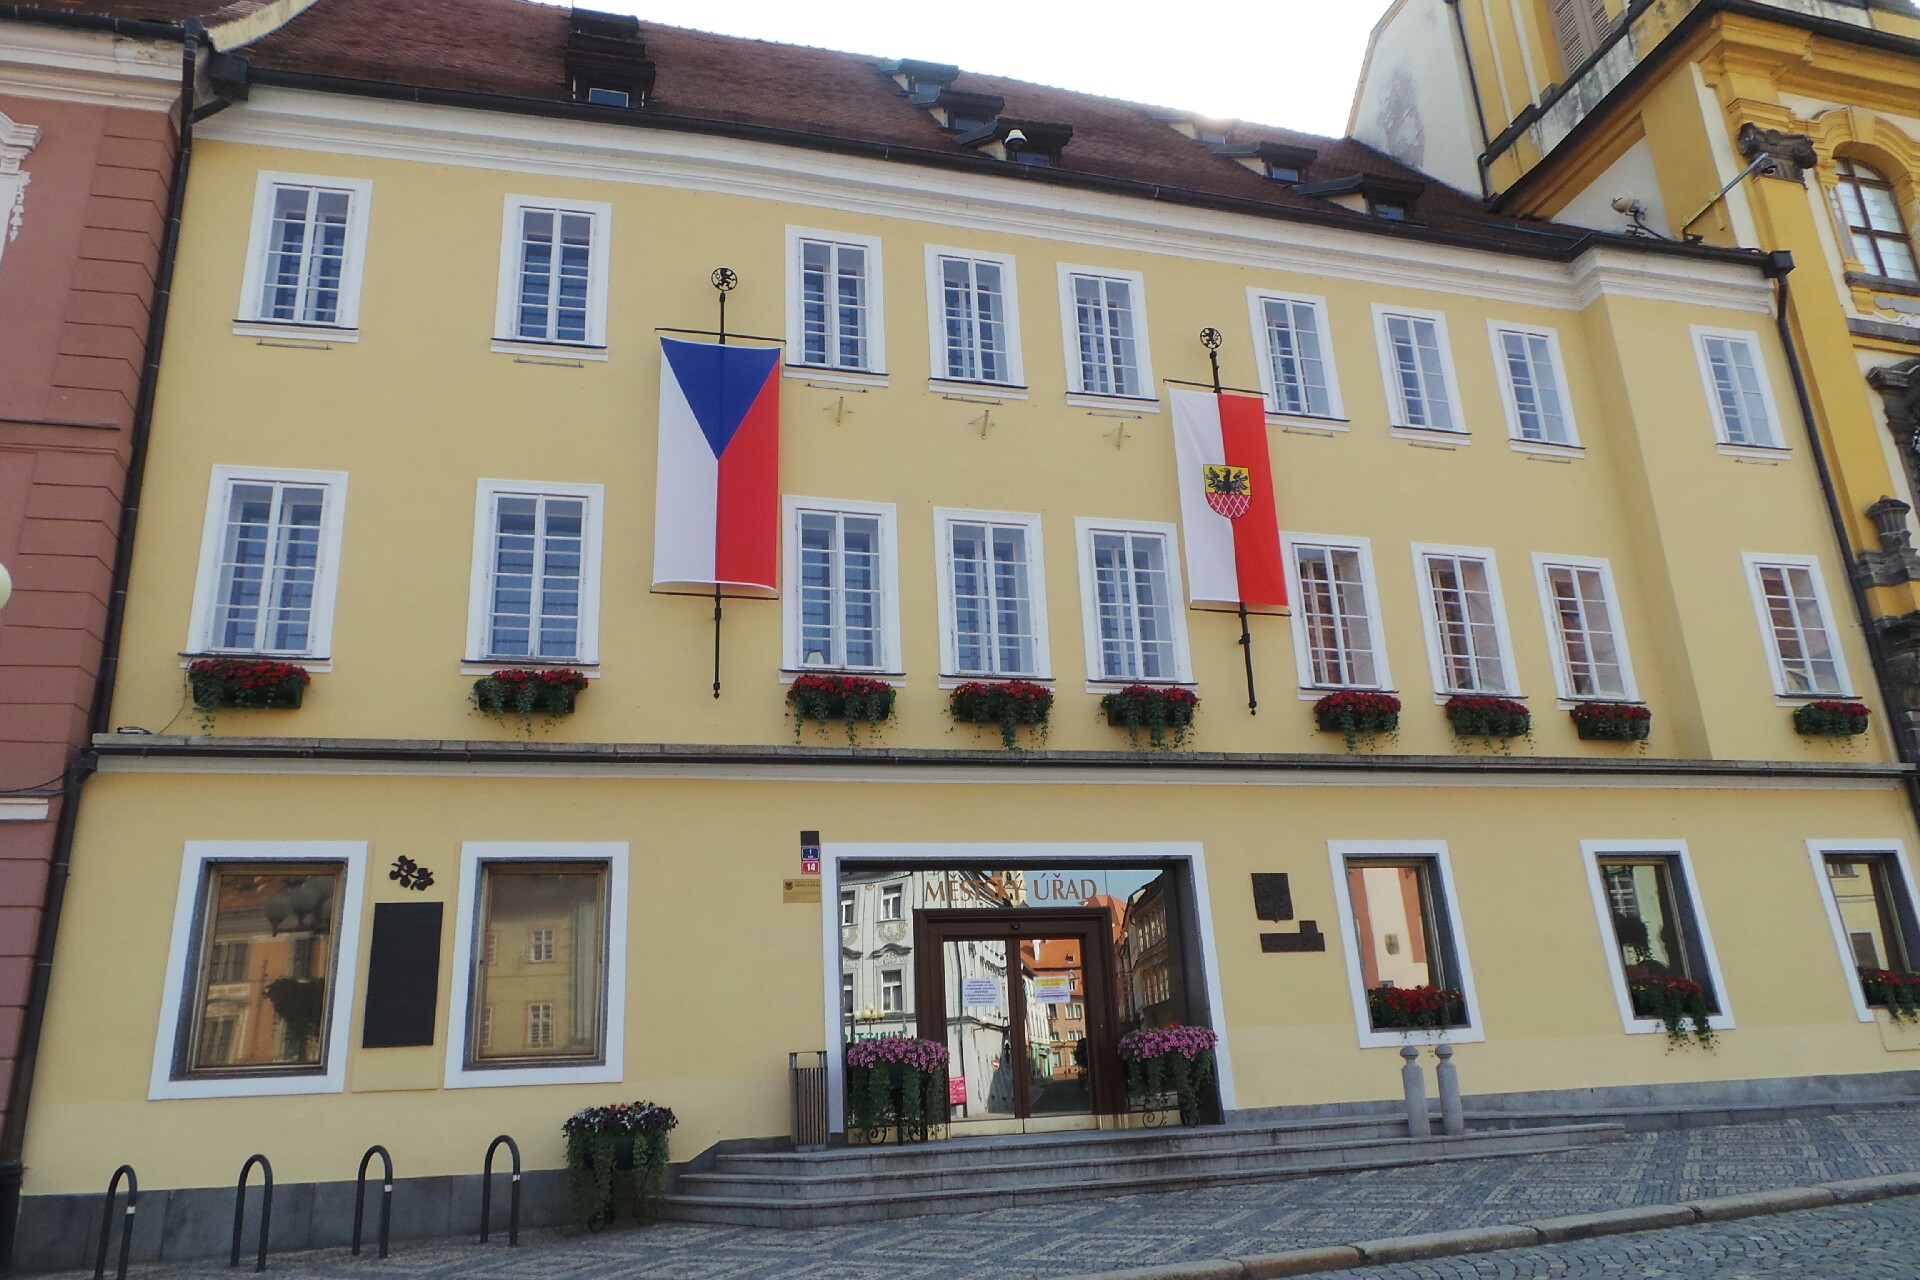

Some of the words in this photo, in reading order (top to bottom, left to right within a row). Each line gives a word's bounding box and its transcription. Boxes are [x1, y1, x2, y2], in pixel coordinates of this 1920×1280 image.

[806, 863, 816, 871] 14
[924, 873, 1023, 902] MĚSTSKÝ
[1033, 872, 1098, 901] ÚŘAD
